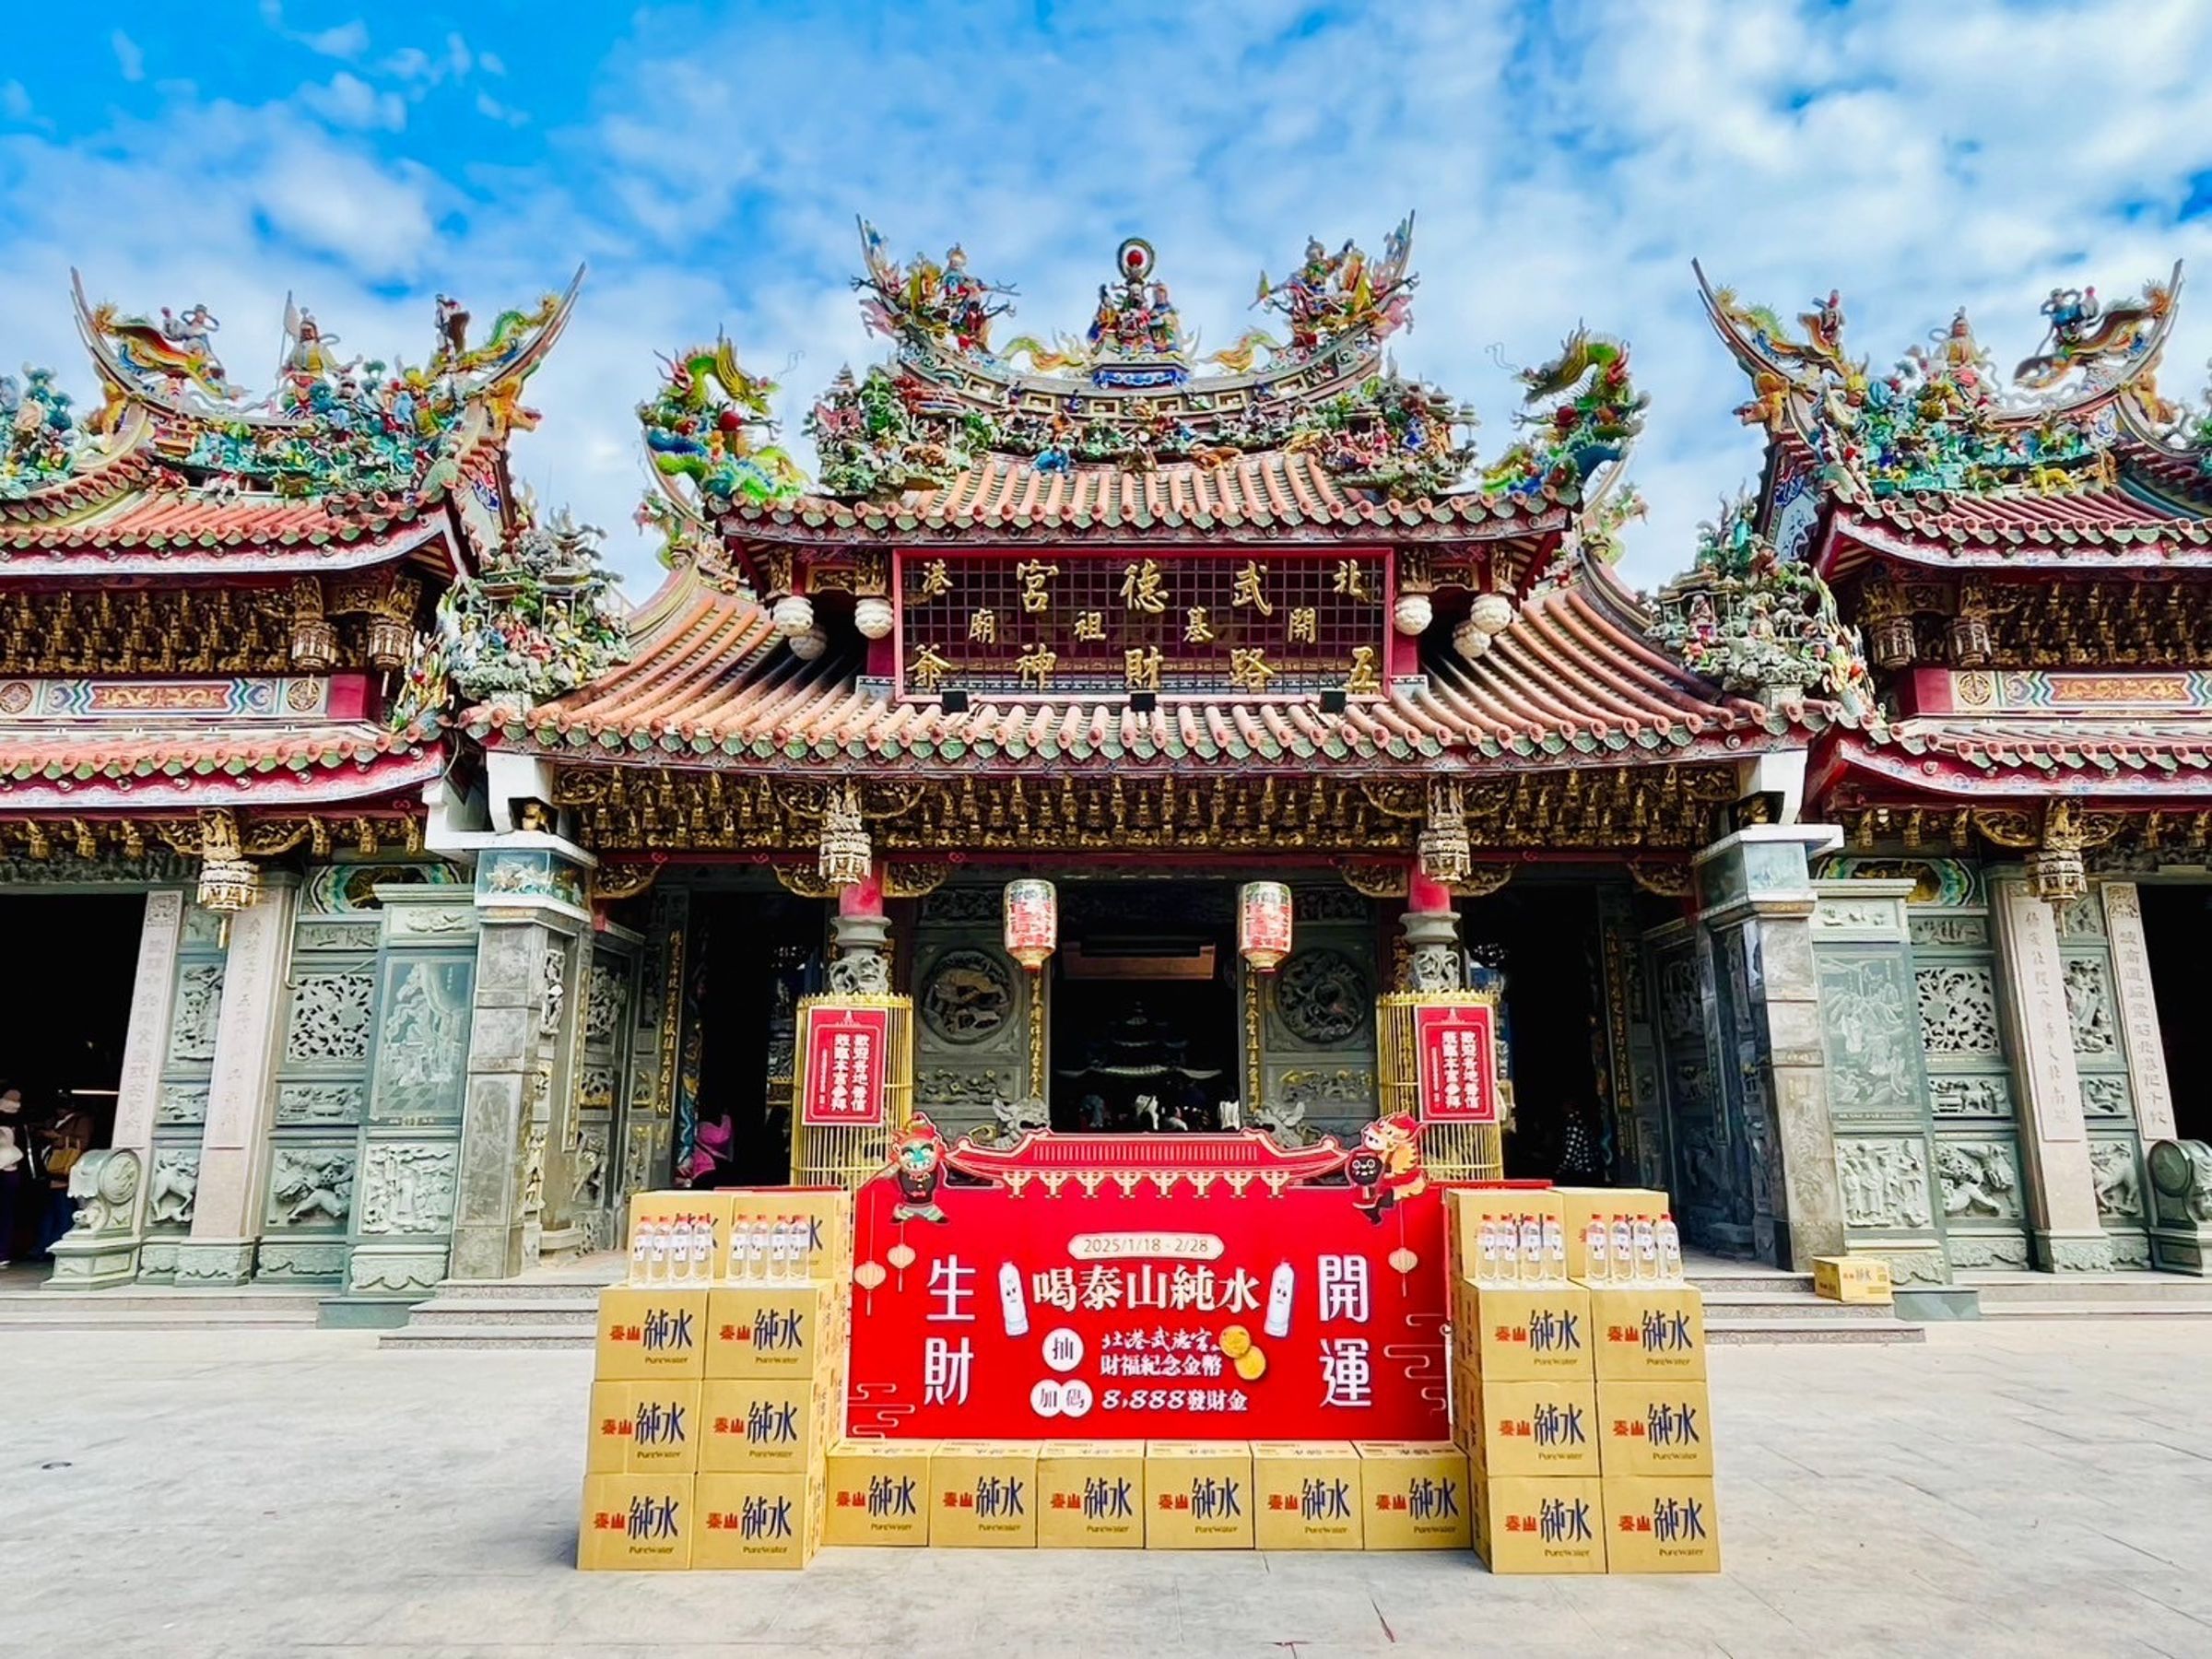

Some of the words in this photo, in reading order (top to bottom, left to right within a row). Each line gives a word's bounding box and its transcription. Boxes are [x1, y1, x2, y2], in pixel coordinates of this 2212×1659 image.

[1031, 1264, 1261, 1313] 喝泰山純水
[924, 1254, 976, 1406] 生財
[1053, 1336, 1074, 1360] 抽
[1318, 1254, 1371, 1407] 開運
[1100, 1354, 1222, 1377] 財福紀念金幣
